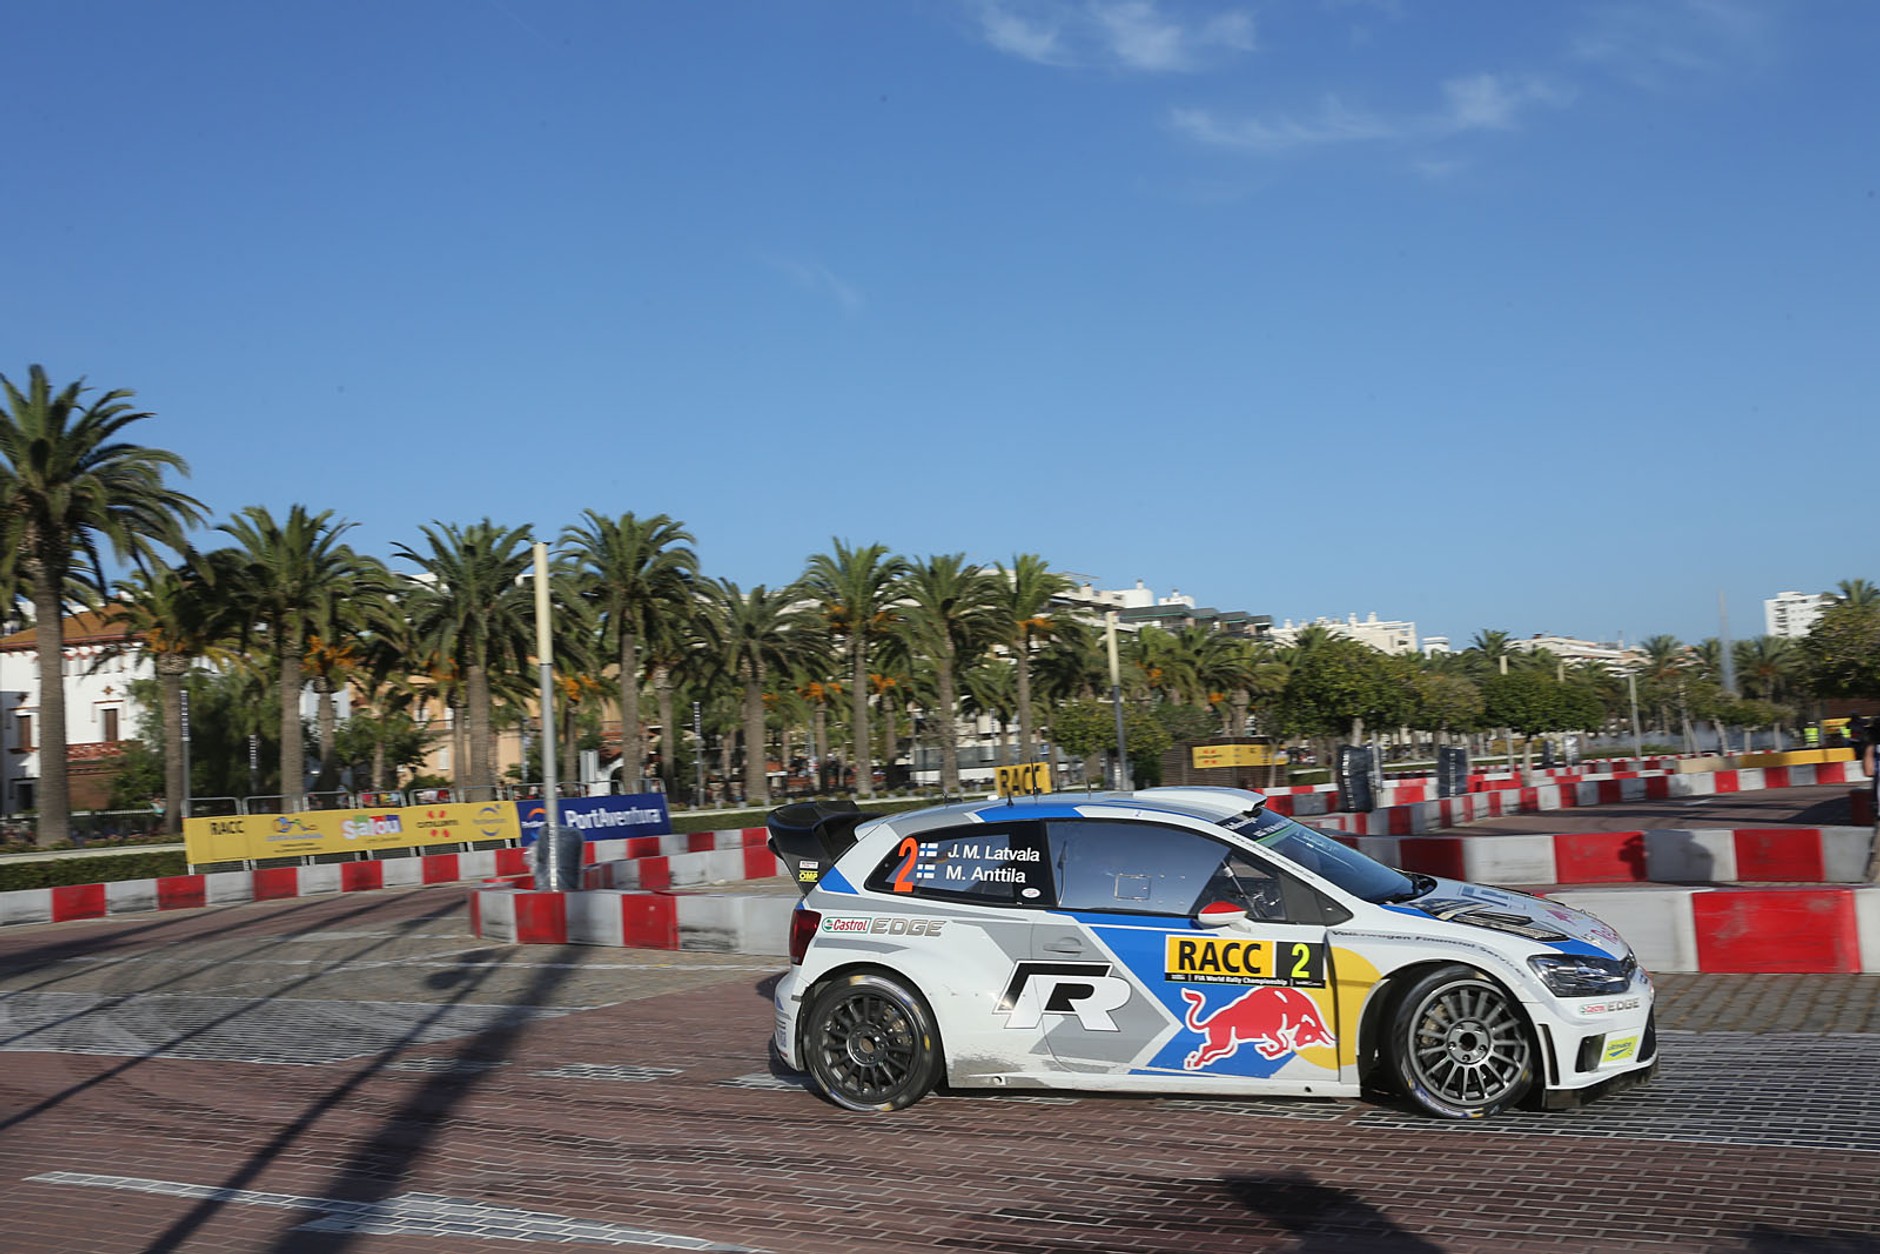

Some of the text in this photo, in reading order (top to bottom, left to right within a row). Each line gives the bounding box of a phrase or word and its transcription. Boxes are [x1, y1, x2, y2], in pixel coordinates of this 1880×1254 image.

[1000, 766, 1042, 794] RACC
[210, 820, 245, 835] RACC
[565, 806, 661, 830] PortAventura
[342, 817, 401, 840] Salou
[948, 844, 1040, 862] J. M. Latvala
[893, 837, 918, 892] 2
[945, 865, 1026, 883] M. Anttila
[799, 871, 818, 881] OMP
[833, 917, 947, 937] Castrol EDGE
[1332, 930, 1411, 941] Volkswagen
[1179, 940, 1261, 974] RACC
[1291, 943, 1310, 978] 2
[1226, 977, 1242, 985] Rally
[1243, 977, 1288, 986] Championship
[992, 959, 1132, 1052] R
[1608, 997, 1640, 1011] EDGE
